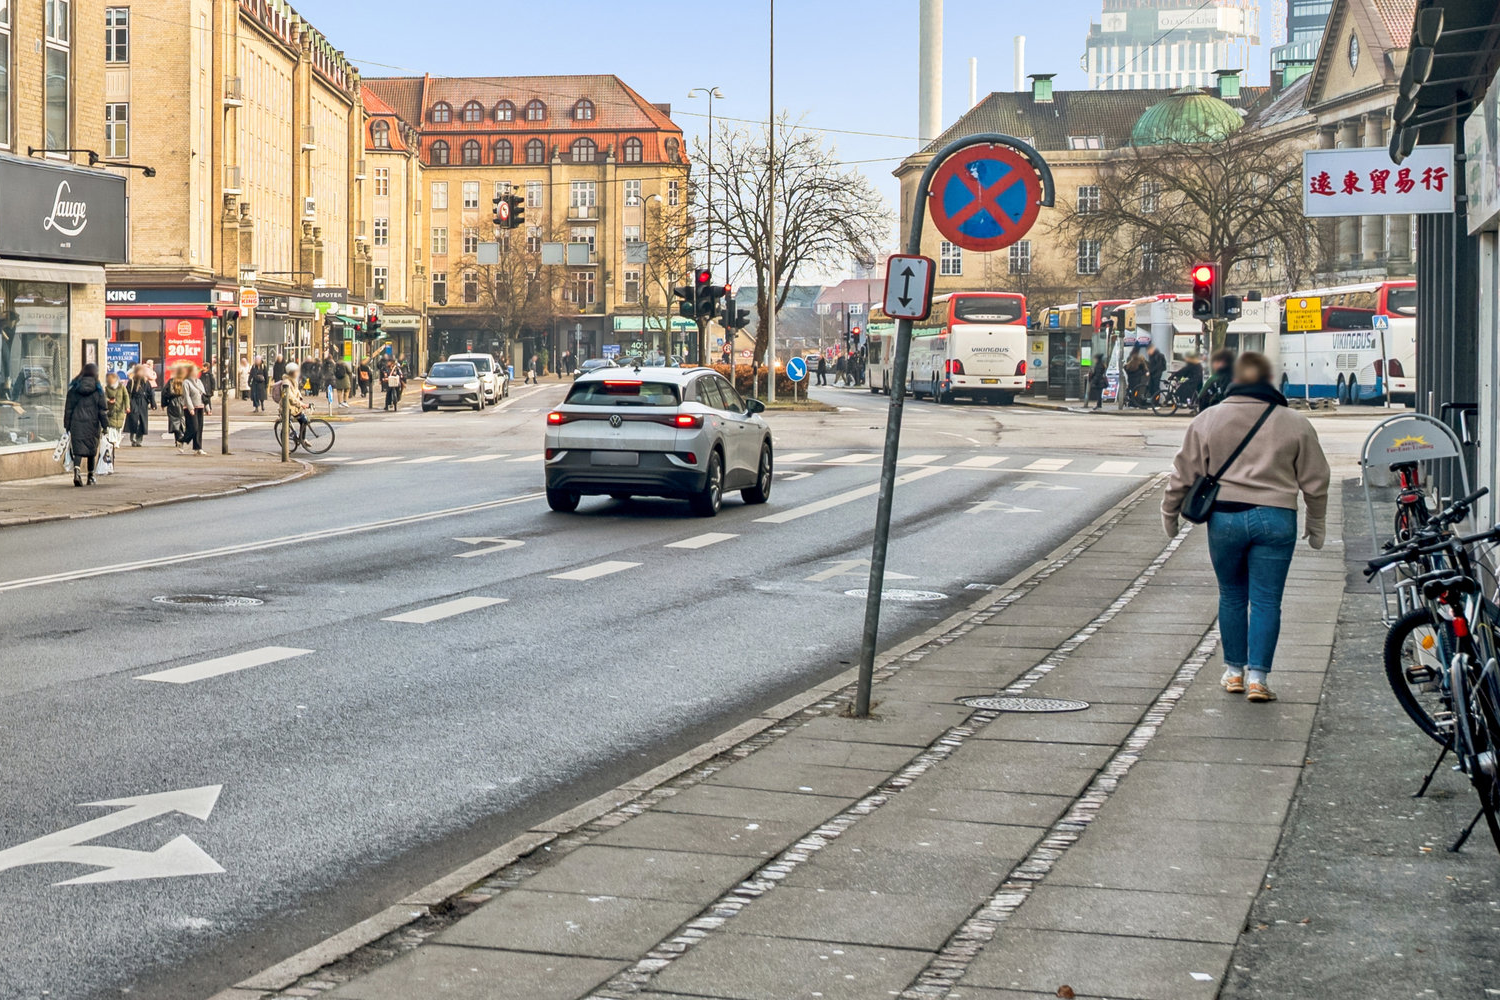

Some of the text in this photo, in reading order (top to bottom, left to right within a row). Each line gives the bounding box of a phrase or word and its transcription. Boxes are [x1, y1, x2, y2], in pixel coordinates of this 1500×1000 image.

[44, 180, 87, 236] Lauge
[106, 291, 136, 301] KING
[168, 344, 202, 356] 20kr
